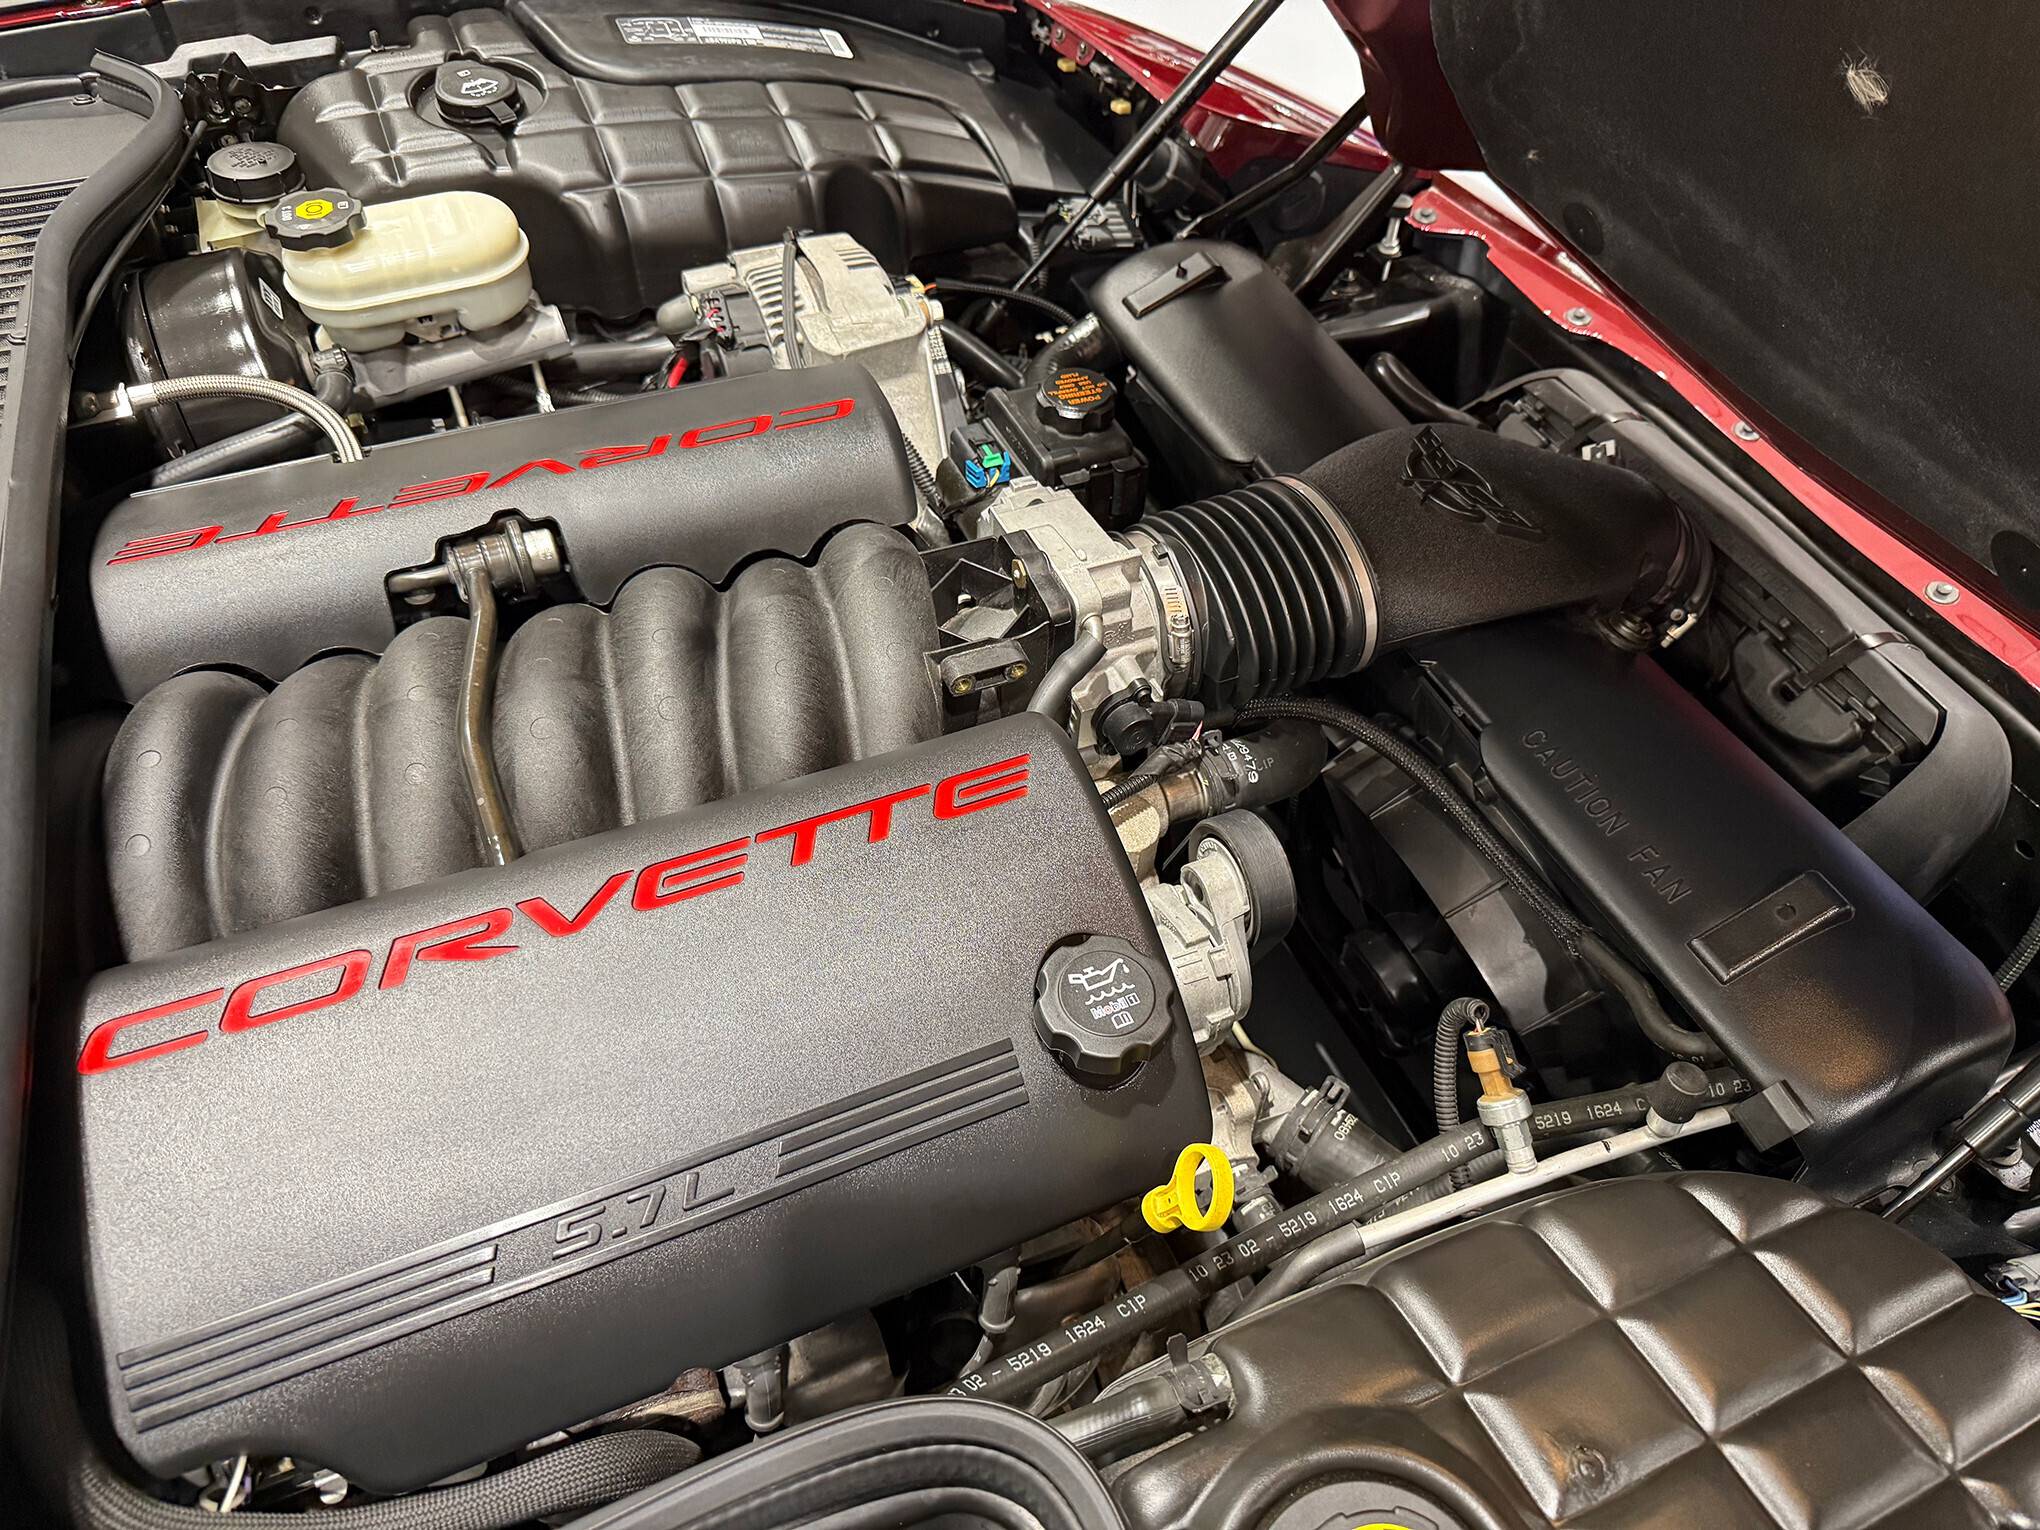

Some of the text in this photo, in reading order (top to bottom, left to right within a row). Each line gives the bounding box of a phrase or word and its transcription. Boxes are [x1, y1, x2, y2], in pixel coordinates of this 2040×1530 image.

[1059, 388, 1102, 400] STEERING
[1068, 395, 1102, 405] POWER
[108, 398, 856, 565] CORVETTE
[1522, 729, 1693, 905] CAUTION FAN
[77, 754, 1029, 1076] CORVETTE
[1090, 996, 1129, 1020] Mobil
[1442, 1144, 1460, 1162] 10
[1465, 1131, 1484, 1151] 23
[1535, 1111, 1573, 1130] 5219
[1586, 1100, 1623, 1121] 1624
[1708, 1082, 1725, 1098] 10
[1732, 1079, 1752, 1093] 23
[552, 1171, 735, 1260] 5.7L
[1188, 1265, 1208, 1283] 10
[1212, 1251, 1235, 1271] 23
[1238, 1239, 1260, 1258] 02
[1278, 1211, 1317, 1238] 5219
[1328, 1188, 1364, 1216] 1624
[963, 1374, 987, 1392] 02
[1006, 1342, 1053, 1373] 5219
[1065, 1315, 1106, 1344] 1624
